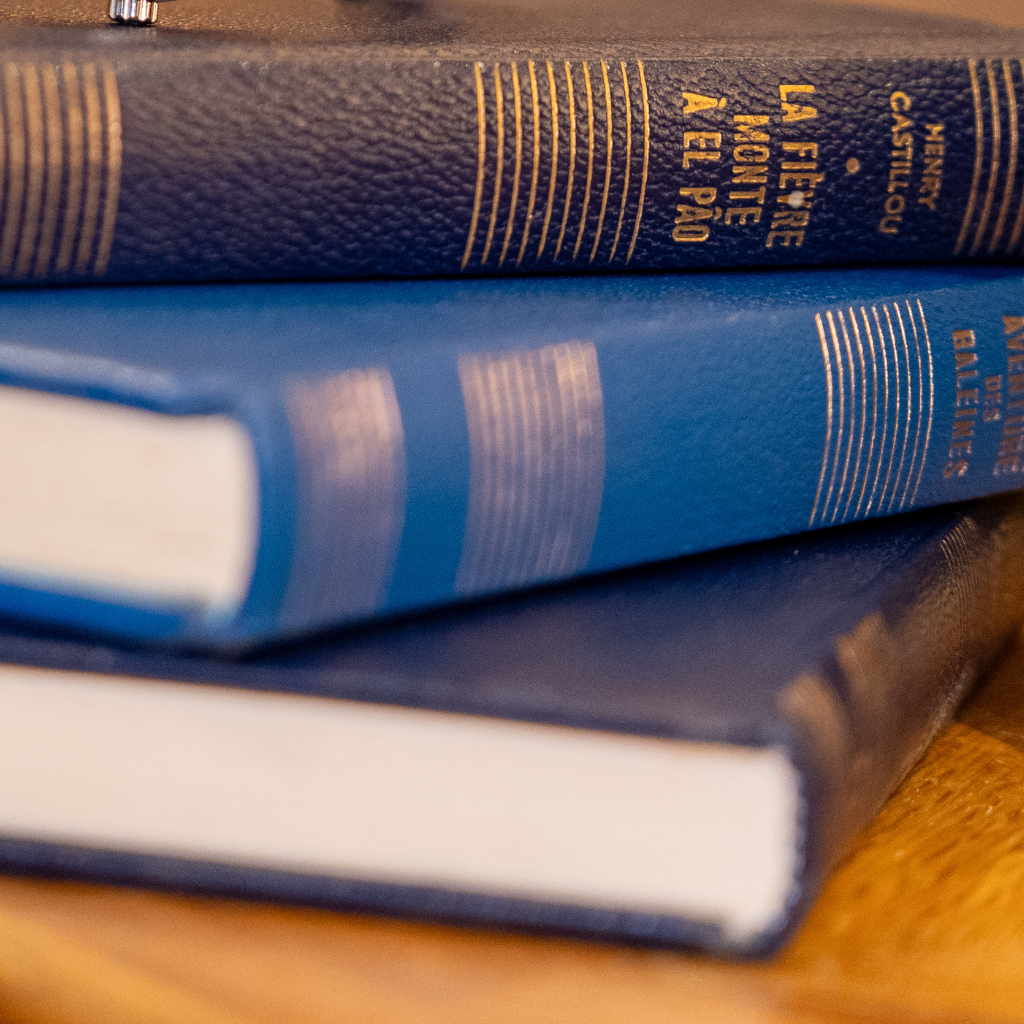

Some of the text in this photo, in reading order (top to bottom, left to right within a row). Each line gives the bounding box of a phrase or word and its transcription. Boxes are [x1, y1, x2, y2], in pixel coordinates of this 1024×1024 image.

[682, 92, 727, 114] À
[779, 84, 817, 122] LA
[682, 131, 721, 169] EL
[724, 114, 770, 225] MONTE
[879, 91, 913, 234] CASTILLOU
[917, 123, 945, 211] HENRY
[943, 329, 979, 478] BALEINES
[983, 375, 1002, 422] DES
